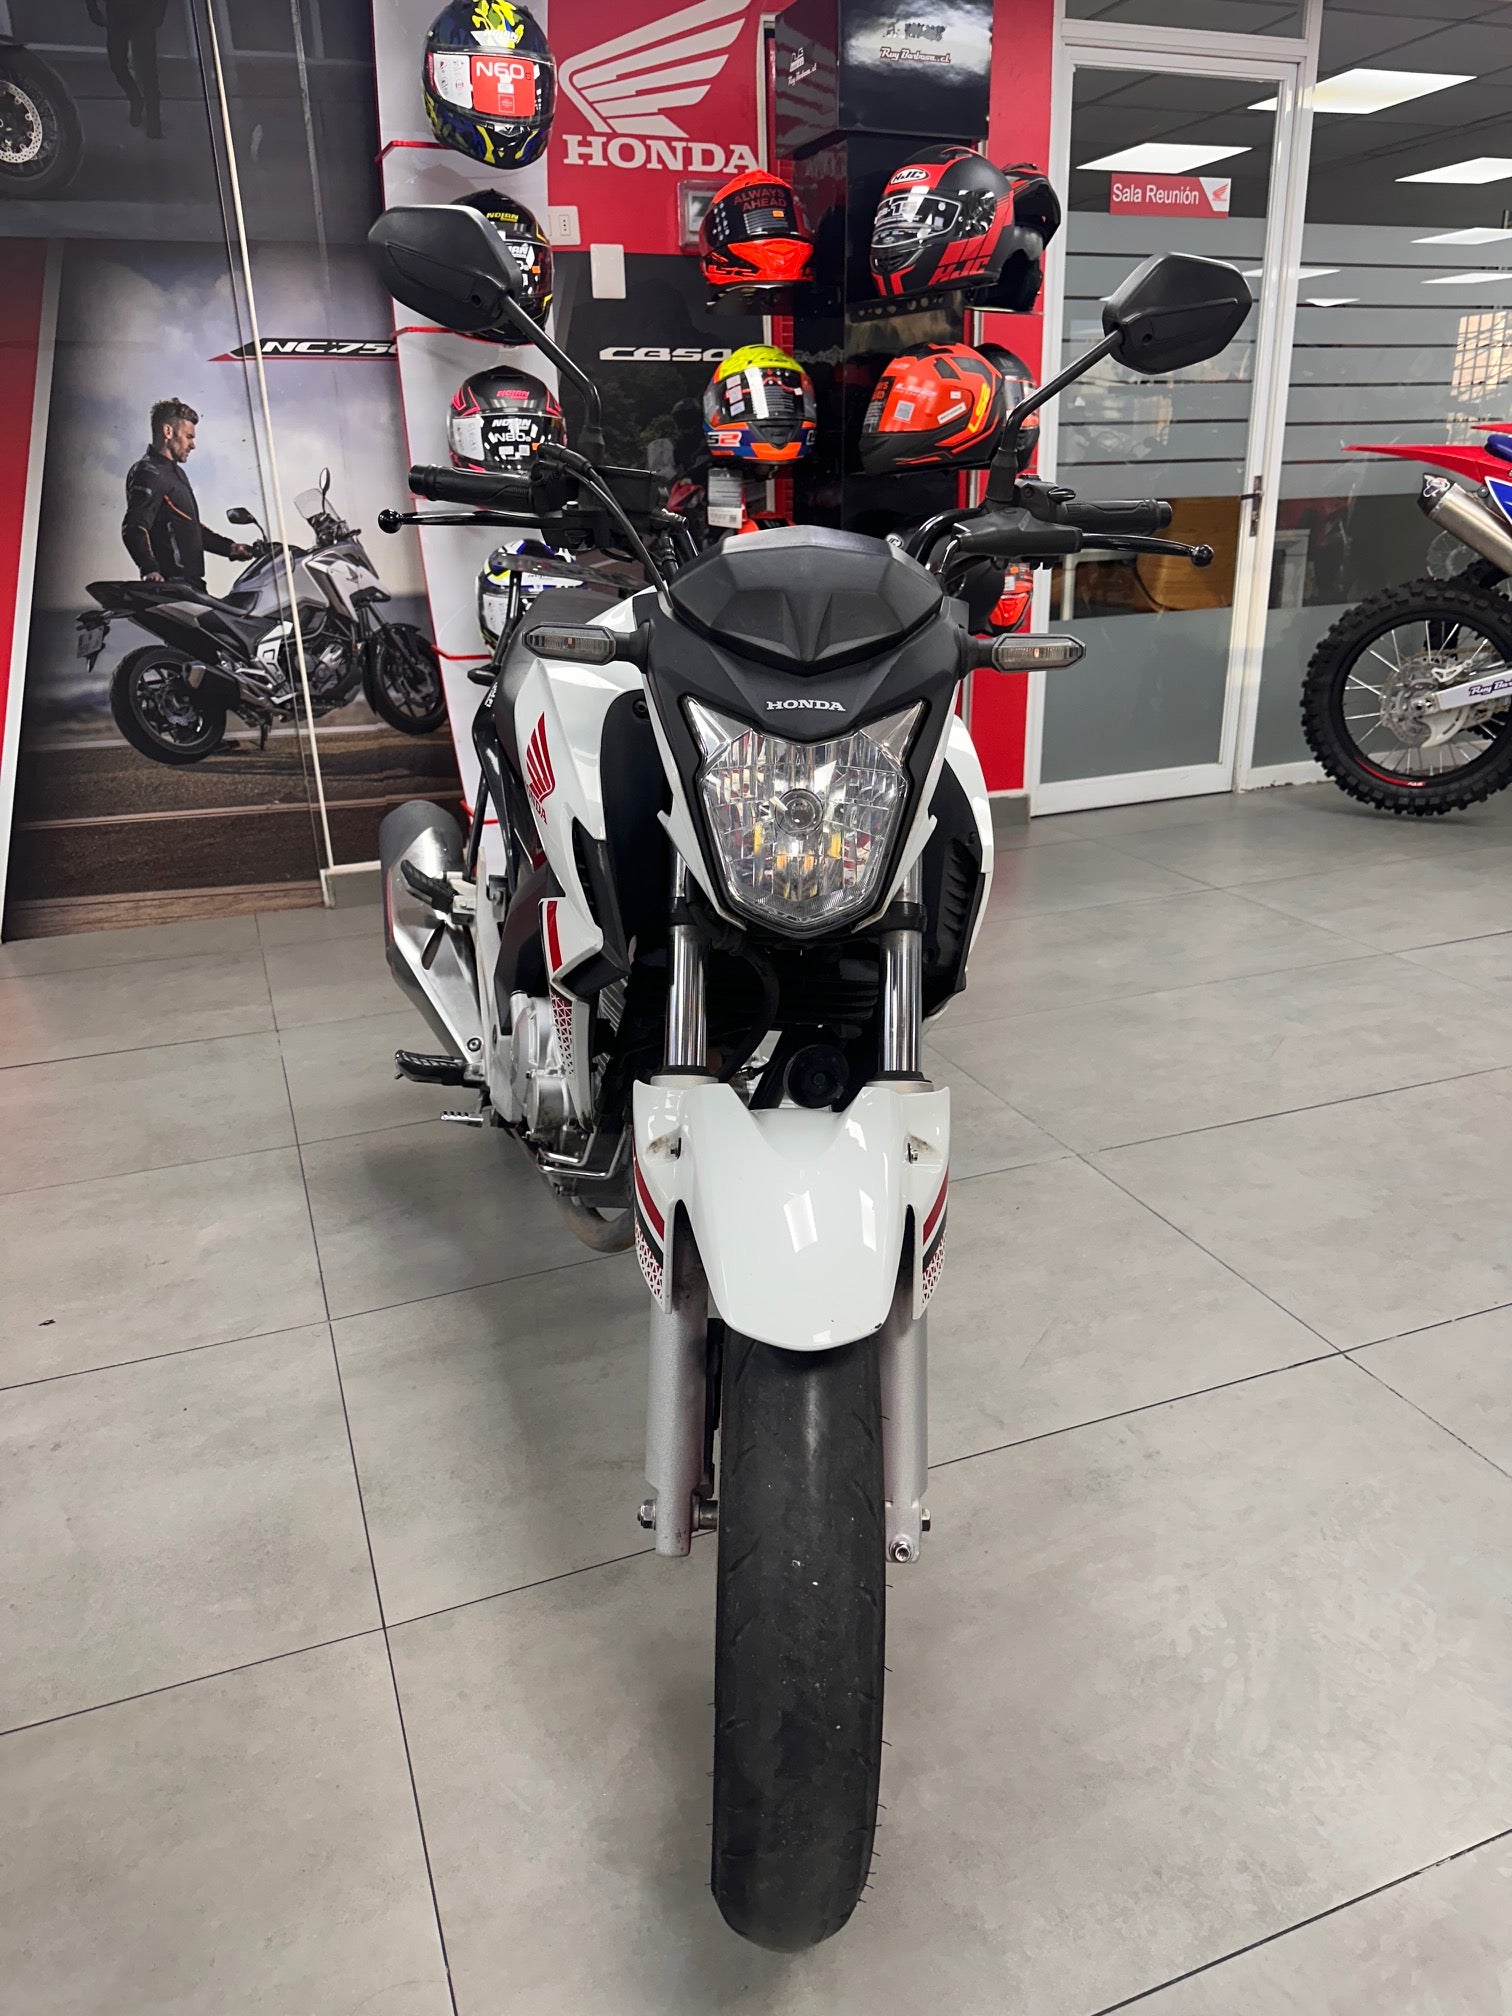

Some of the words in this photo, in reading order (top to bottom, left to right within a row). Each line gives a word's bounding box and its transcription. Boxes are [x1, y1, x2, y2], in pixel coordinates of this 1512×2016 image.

[562, 134, 758, 174] HONDA
[892, 170, 924, 183] HJC
[733, 188, 786, 206] ALWAYS
[1112, 183, 1142, 203] Sala
[1145, 185, 1199, 205] Reunión
[742, 198, 788, 212] AHEAD
[486, 212, 519, 223] NOLAN
[927, 256, 991, 287] HJC
[496, 389, 530, 400] NOLAN
[491, 418, 532, 431] NOAN
[765, 699, 847, 712] HONDA
